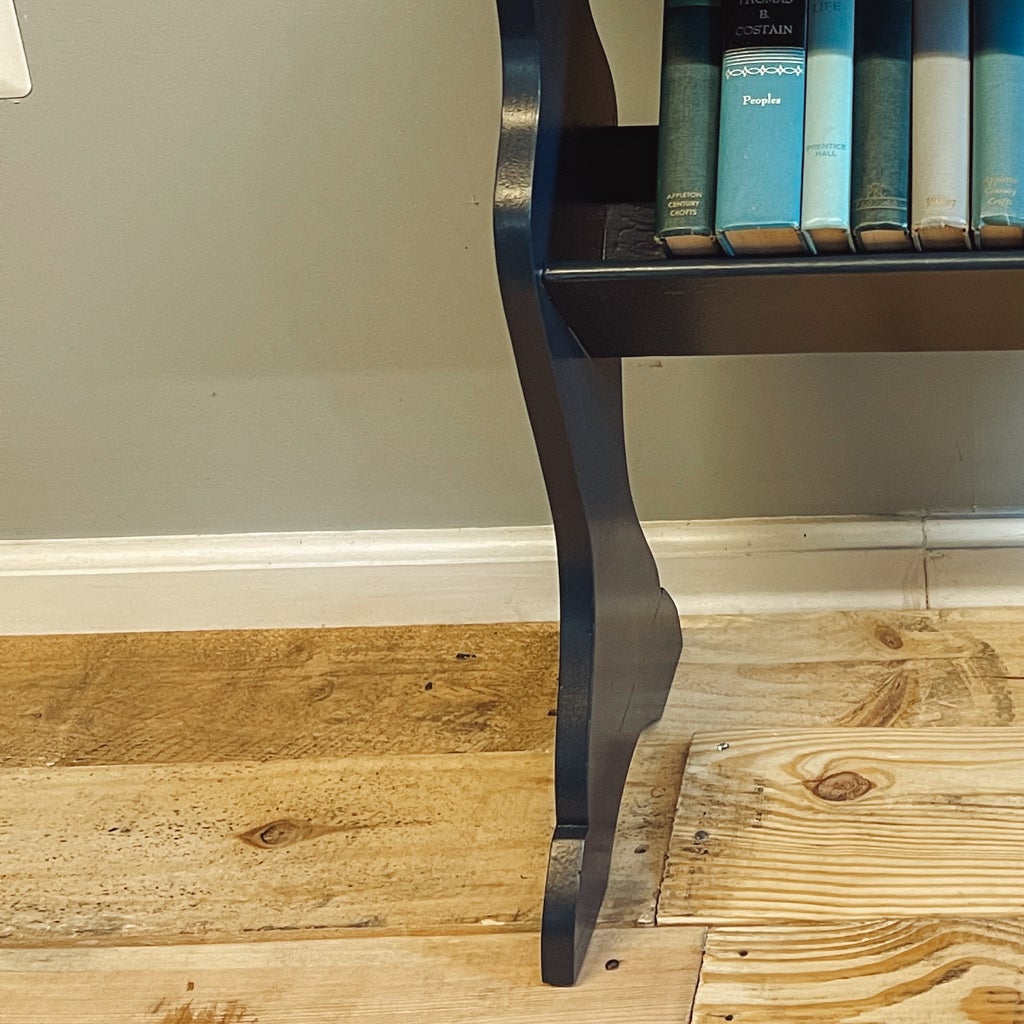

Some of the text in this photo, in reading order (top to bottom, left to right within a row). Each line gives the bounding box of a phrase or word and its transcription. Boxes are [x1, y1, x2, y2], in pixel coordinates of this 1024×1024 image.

[812, 1, 841, 13] LIFE
[735, 26, 793, 36] COSTAIN
[742, 93, 781, 106] Peoples
[807, 143, 847, 152] PRENTICE
